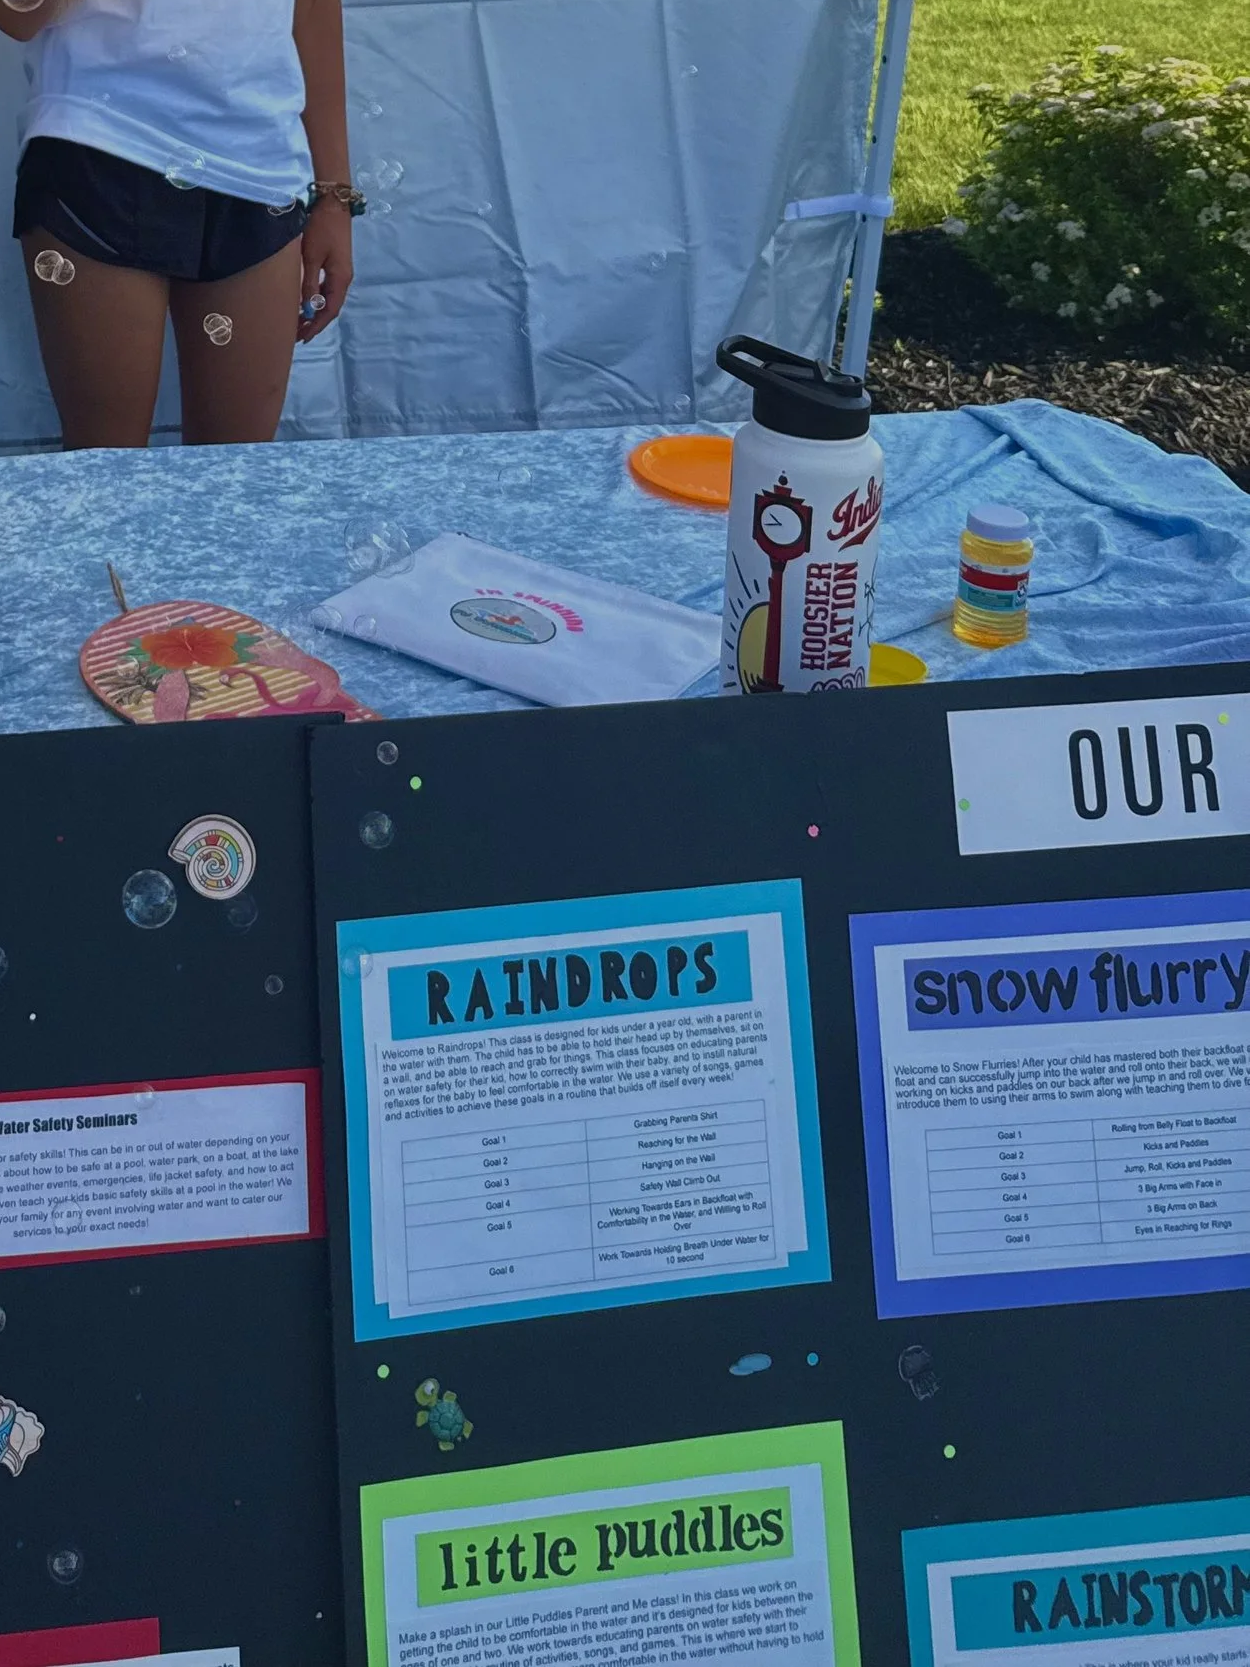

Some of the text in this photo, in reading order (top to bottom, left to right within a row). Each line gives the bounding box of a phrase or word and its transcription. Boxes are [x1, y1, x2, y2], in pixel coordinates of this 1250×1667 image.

[800, 562, 832, 671] HOOSIER
[827, 561, 858, 671] NATION
[1069, 724, 1220, 820] OUR
[427, 942, 716, 1025] RAINDROPS
[914, 950, 1250, 1015] snow flurry
[381, 1048, 423, 1059] Welcome
[426, 1046, 435, 1054] to
[437, 1039, 485, 1053] Raindrops!
[488, 1037, 507, 1046] This
[509, 1035, 532, 1045] class
[534, 1033, 541, 1042] is
[544, 1027, 584, 1043] designed
[587, 1026, 598, 1036] for
[601, 1025, 619, 1034] kids
[621, 1022, 646, 1032] under
[656, 1019, 675, 1030] year
[677, 1016, 693, 1030] old,
[696, 1014, 713, 1024] with
[724, 1010, 752, 1023] parent
[754, 1010, 762, 1018] in
[893, 1044, 1243, 1075] Welcome to Snow Flurries! After your child has mastered both their backfloat
[32, 1117, 73, 1132] Safety
[76, 1113, 137, 1129] Seminars
[633, 1111, 718, 1128] Grabbing Parents Shirt
[1111, 1124, 1136, 1133] Rolling
[1156, 1120, 1173, 1130] Belly
[1175, 1119, 1193, 1127] Float
[1195, 1118, 1202, 1126] to
[1203, 1116, 1236, 1125] Backfloat
[481, 1136, 500, 1146] Goal
[638, 1132, 716, 1148] Reaching for the Wall
[997, 1130, 1021, 1139] Goal 1
[1143, 1139, 1209, 1150] Kicks and Paddles
[9, 1152, 37, 1162] safety
[40, 1149, 65, 1159] skills!
[68, 1148, 88, 1157] This
[90, 1147, 107, 1155] can
[110, 1145, 122, 1154] be
[125, 1145, 133, 1153] in
[136, 1144, 145, 1152] or
[148, 1142, 162, 1151] out
[165, 1140, 174, 1150] of
[177, 1140, 202, 1149] water
[204, 1136, 253, 1148] depending
[270, 1133, 289, 1144] your
[999, 1151, 1023, 1160] Goal 2
[483, 1156, 507, 1167] Goal 2
[439, 1504, 784, 1591] little puddles
[399, 1580, 796, 1644] Make a splash in our Little Puddles Parent and Me class! In this class we work on
[1192, 1652, 1218, 1664] really
